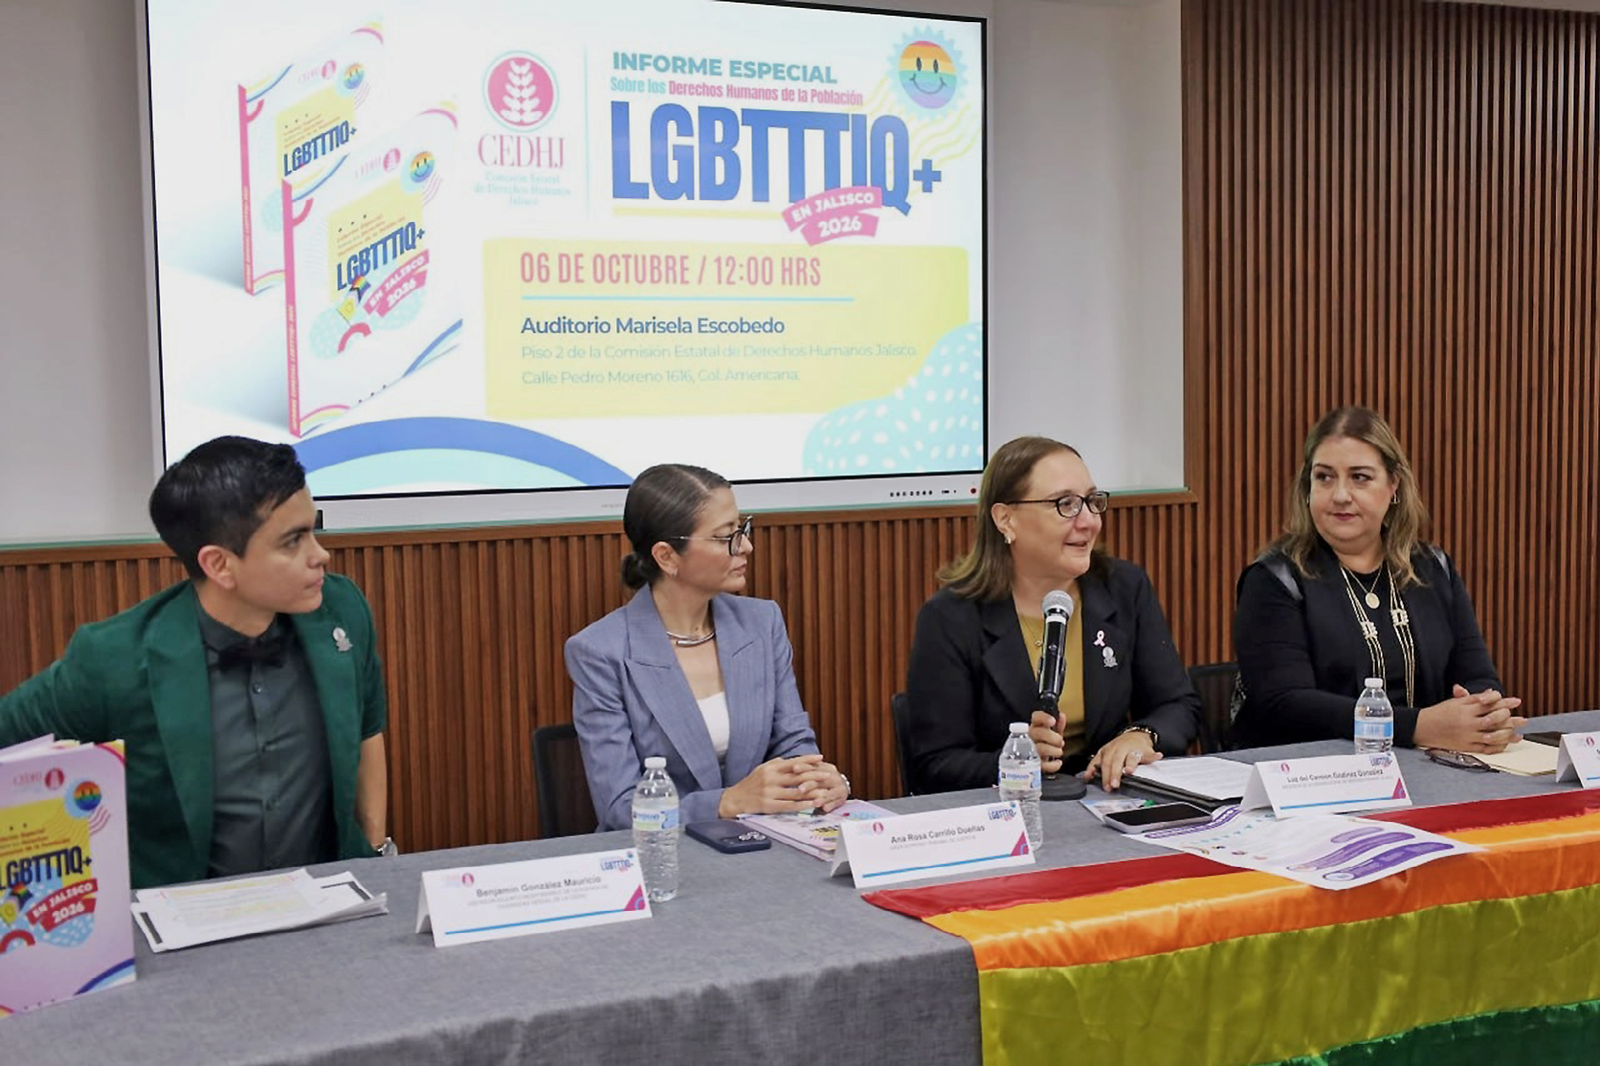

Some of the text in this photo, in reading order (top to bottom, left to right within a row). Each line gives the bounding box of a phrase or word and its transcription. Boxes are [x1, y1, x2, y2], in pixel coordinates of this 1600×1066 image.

[612, 51, 838, 84] INFORME ESPECIAL
[611, 76, 864, 106] Sobre los Derechos Humanos de la Población
[477, 133, 567, 169] CEDHJ
[611, 100, 942, 217] LGBTTTIQ+
[790, 193, 874, 222] EN JALISCO
[818, 215, 862, 238] 2026
[520, 252, 821, 286] 06 DE OCTUBRE / 12:00 HRS
[387, 278, 416, 308] 2026
[520, 315, 785, 334] Auditorio Marisela Escobedo
[521, 345, 552, 359] Piso
[555, 346, 564, 359] 2
[567, 345, 586, 359] de
[589, 345, 601, 358] la
[674, 344, 720, 358] Estatal
[722, 344, 740, 358] de
[743, 343, 807, 358] Derechos
[809, 344, 873, 357] Humanos
[521, 370, 558, 385] Calle
[561, 370, 605, 384] Pedro
[608, 370, 663, 383] Moreno
[891, 835, 907, 844] Ana
[907, 832, 927, 842] Rosa
[928, 828, 956, 839] Carrillo
[564, 875, 602, 887] Mauricio
[49, 883, 93, 908] JALISCO
[52, 901, 85, 923] 2026
